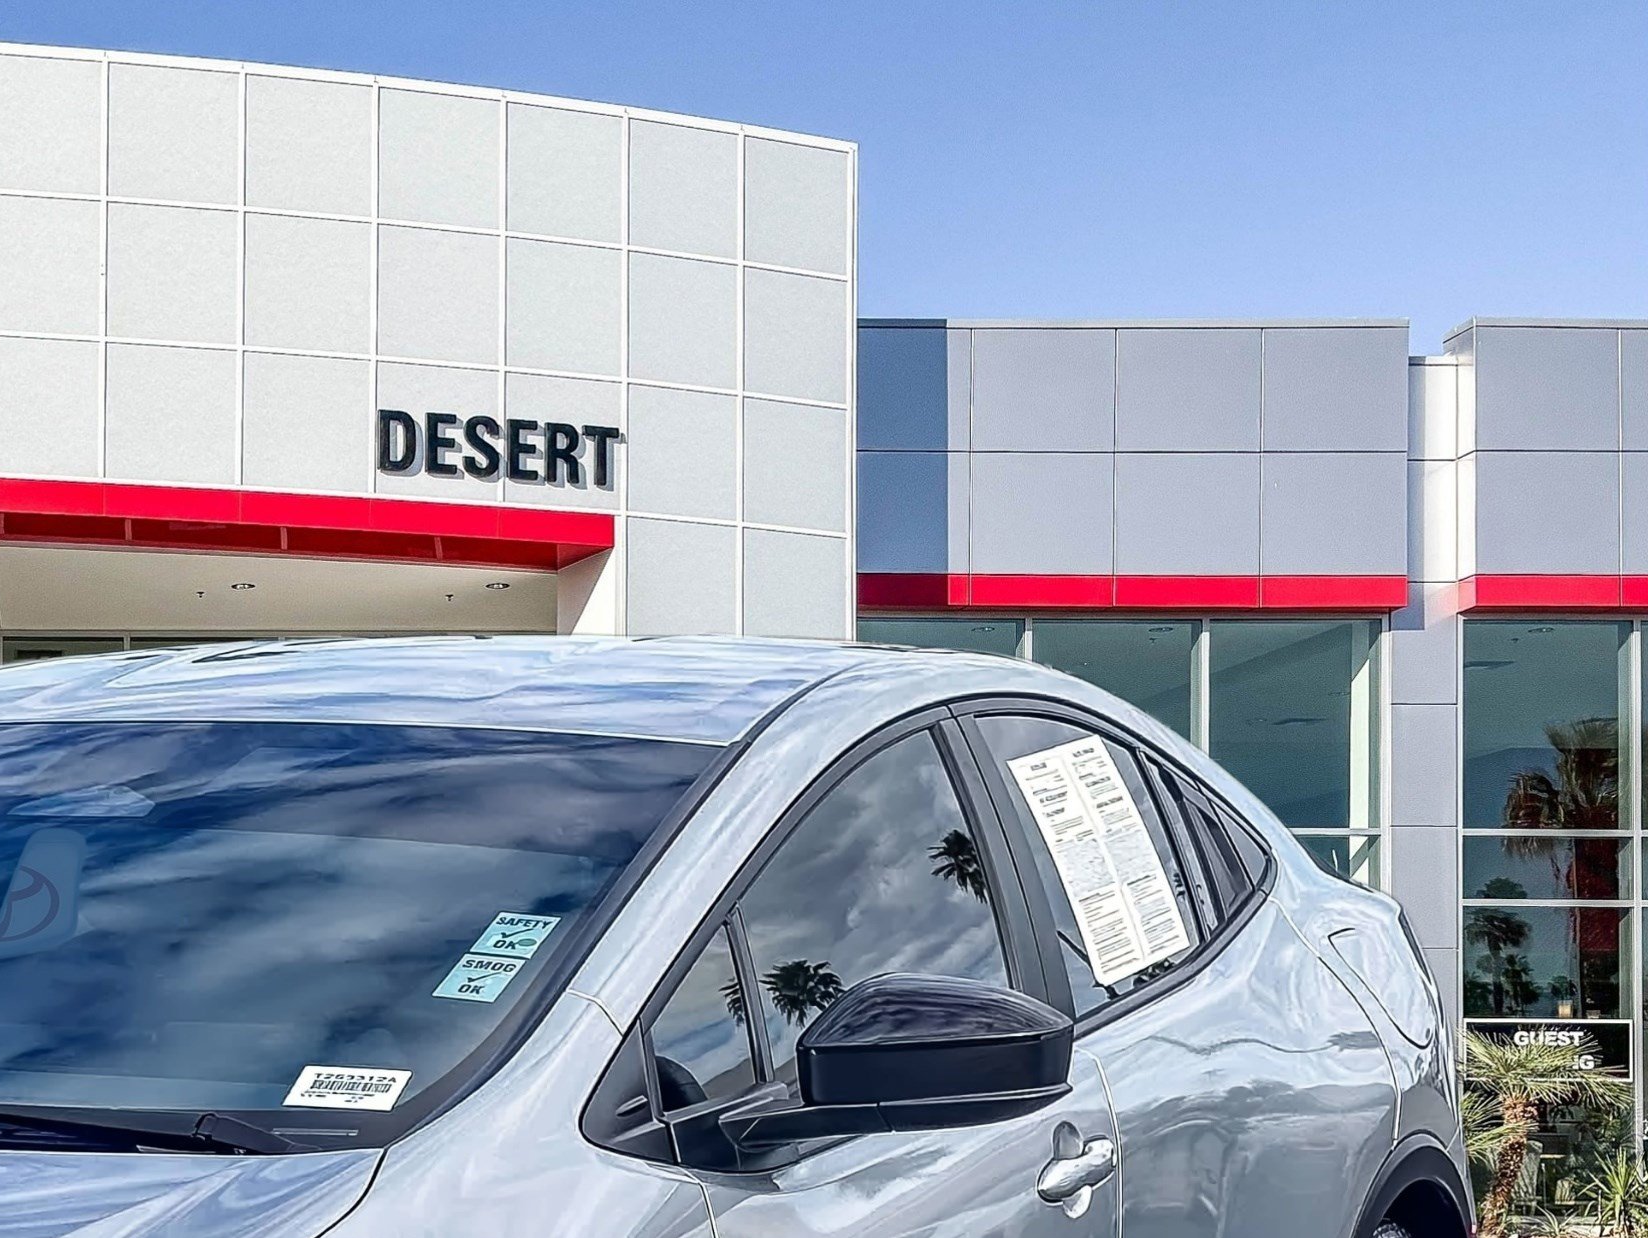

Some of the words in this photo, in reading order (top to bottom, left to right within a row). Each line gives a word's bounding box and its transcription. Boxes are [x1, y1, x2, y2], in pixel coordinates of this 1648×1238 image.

[377, 409, 620, 487] DESERT
[496, 916, 552, 930] SAFETY
[493, 939, 517, 950] OK
[462, 959, 517, 973] SMOG
[457, 984, 485, 995] OK
[1513, 1030, 1584, 1046] GUEST
